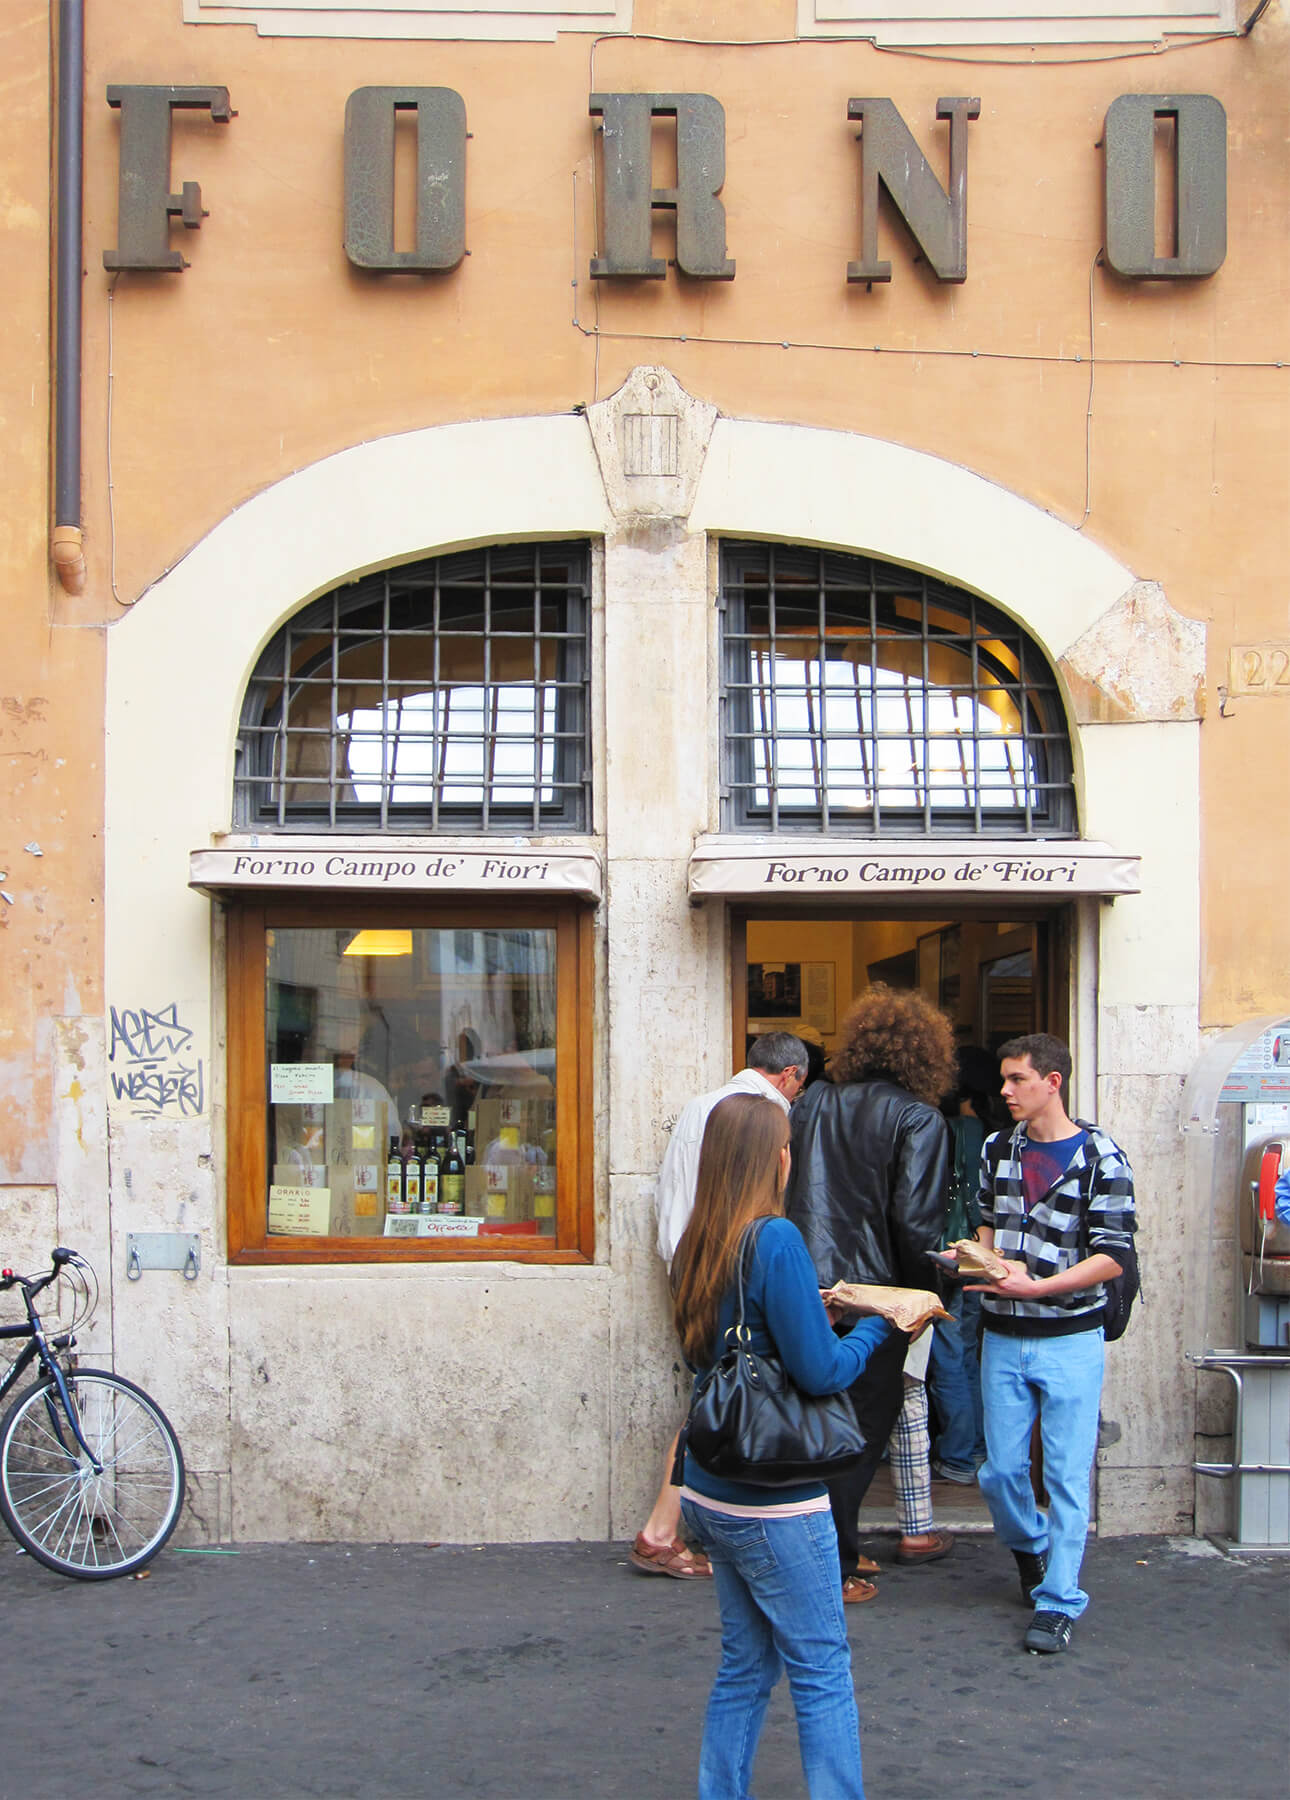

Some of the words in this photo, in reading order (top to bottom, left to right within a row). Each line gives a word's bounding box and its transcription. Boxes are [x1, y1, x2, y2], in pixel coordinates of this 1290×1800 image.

[103, 85, 1227, 282] FORNO
[233, 856, 315, 876] Forno
[325, 856, 416, 882] Campo
[480, 859, 549, 880] Fiori
[764, 862, 849, 883] Forno
[859, 862, 946, 885] Campo
[993, 861, 1077, 882] Fiori
